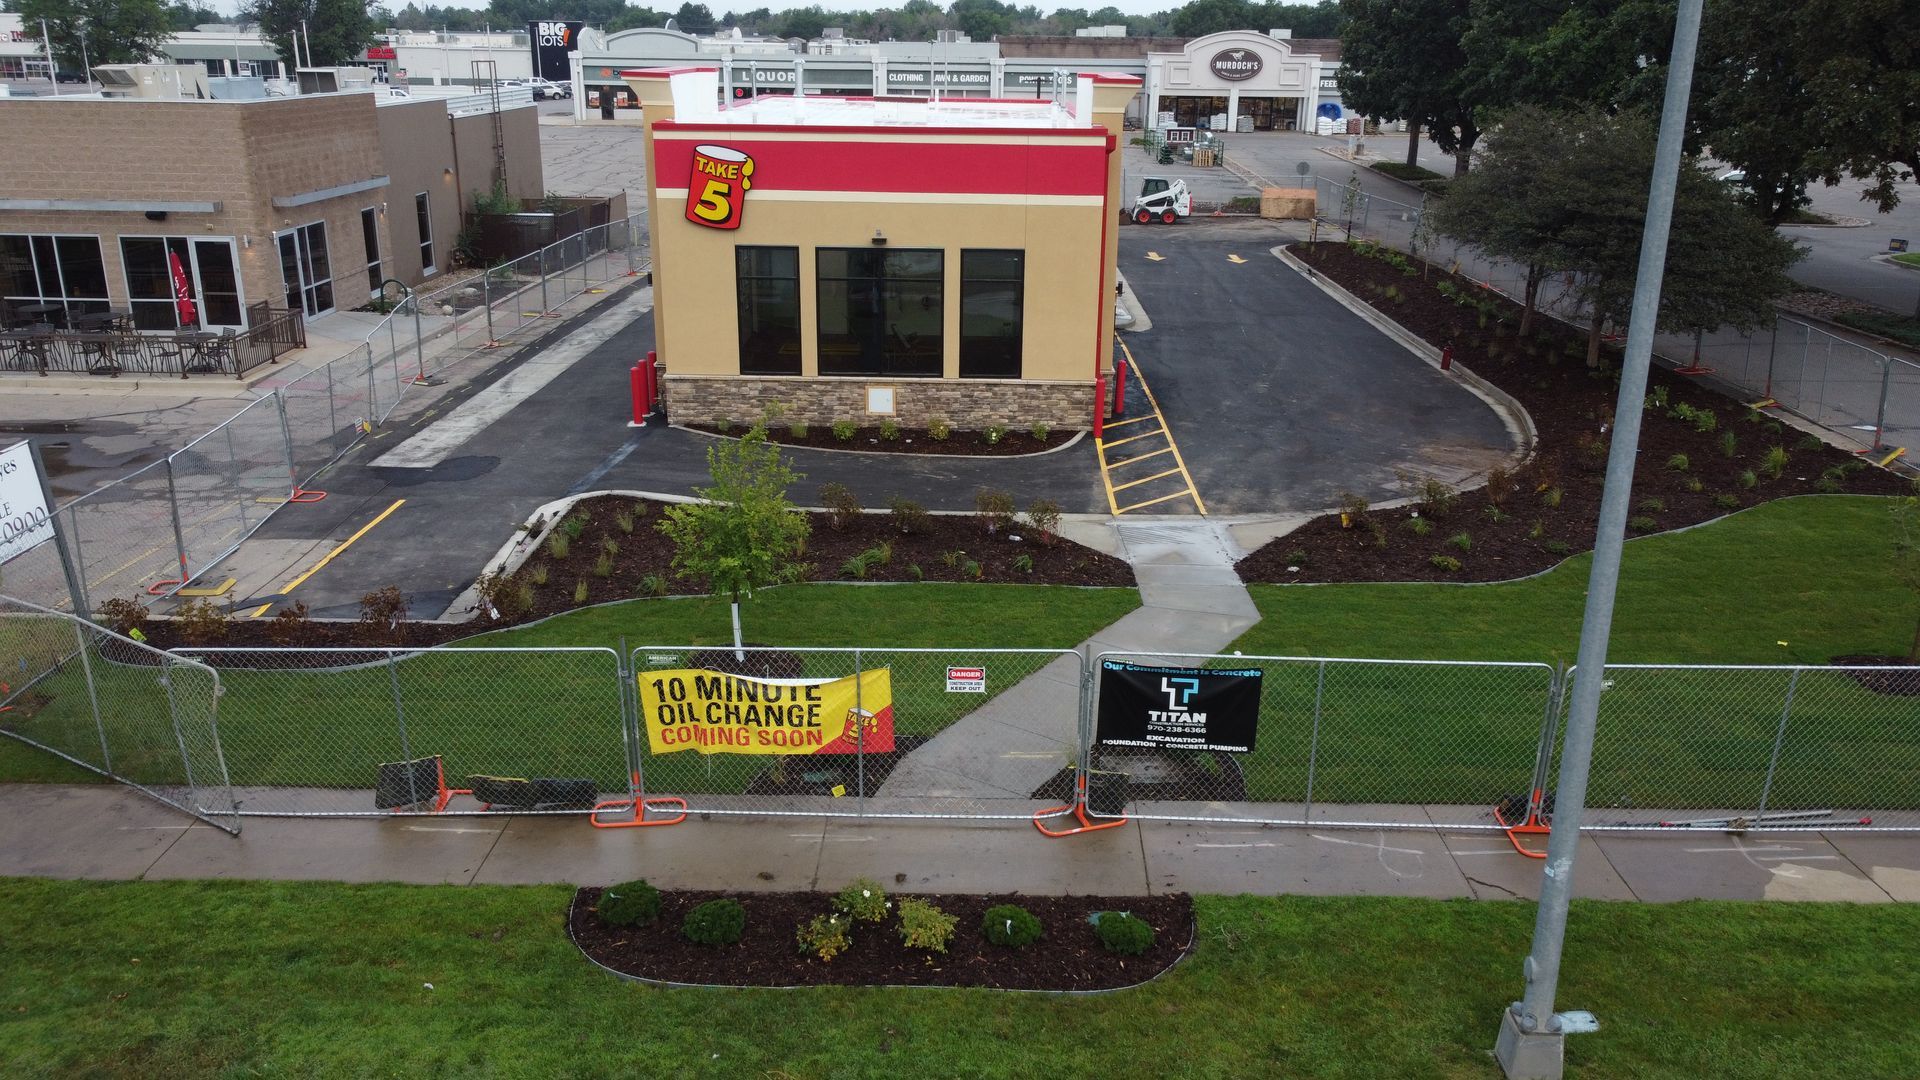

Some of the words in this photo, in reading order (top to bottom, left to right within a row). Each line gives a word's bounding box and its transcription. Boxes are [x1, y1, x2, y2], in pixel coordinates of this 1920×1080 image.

[538, 22, 567, 36] BIG
[540, 30, 571, 47] LOTS!
[1215, 61, 1259, 70] MURDOCH'S
[742, 71, 796, 82] LQUOR
[889, 73, 924, 82] CLOTHING
[932, 74, 951, 82] AWN
[952, 74, 959, 82] &
[960, 74, 989, 82] GARDEN
[1019, 75, 1046, 84] POWR
[1049, 76, 1072, 84] TOS
[696, 156, 739, 179] TAKE
[693, 179, 732, 223] 5
[1103, 661, 1125, 671] Our
[1211, 669, 1262, 677] Concrete
[652, 677, 687, 703] 10
[694, 674, 822, 704] MINUTE
[657, 702, 700, 727] OIL
[705, 702, 822, 728] CHANGE
[1148, 710, 1207, 724] TITAN
[661, 725, 750, 747] COMING
[757, 729, 824, 747] SOON
[1147, 724, 1207, 734] 970-238-6366
[1102, 739, 1157, 748] FOUNDATION
[1209, 744, 1248, 752] PUMPING
[1146, 734, 1206, 743] EXCAVATION
